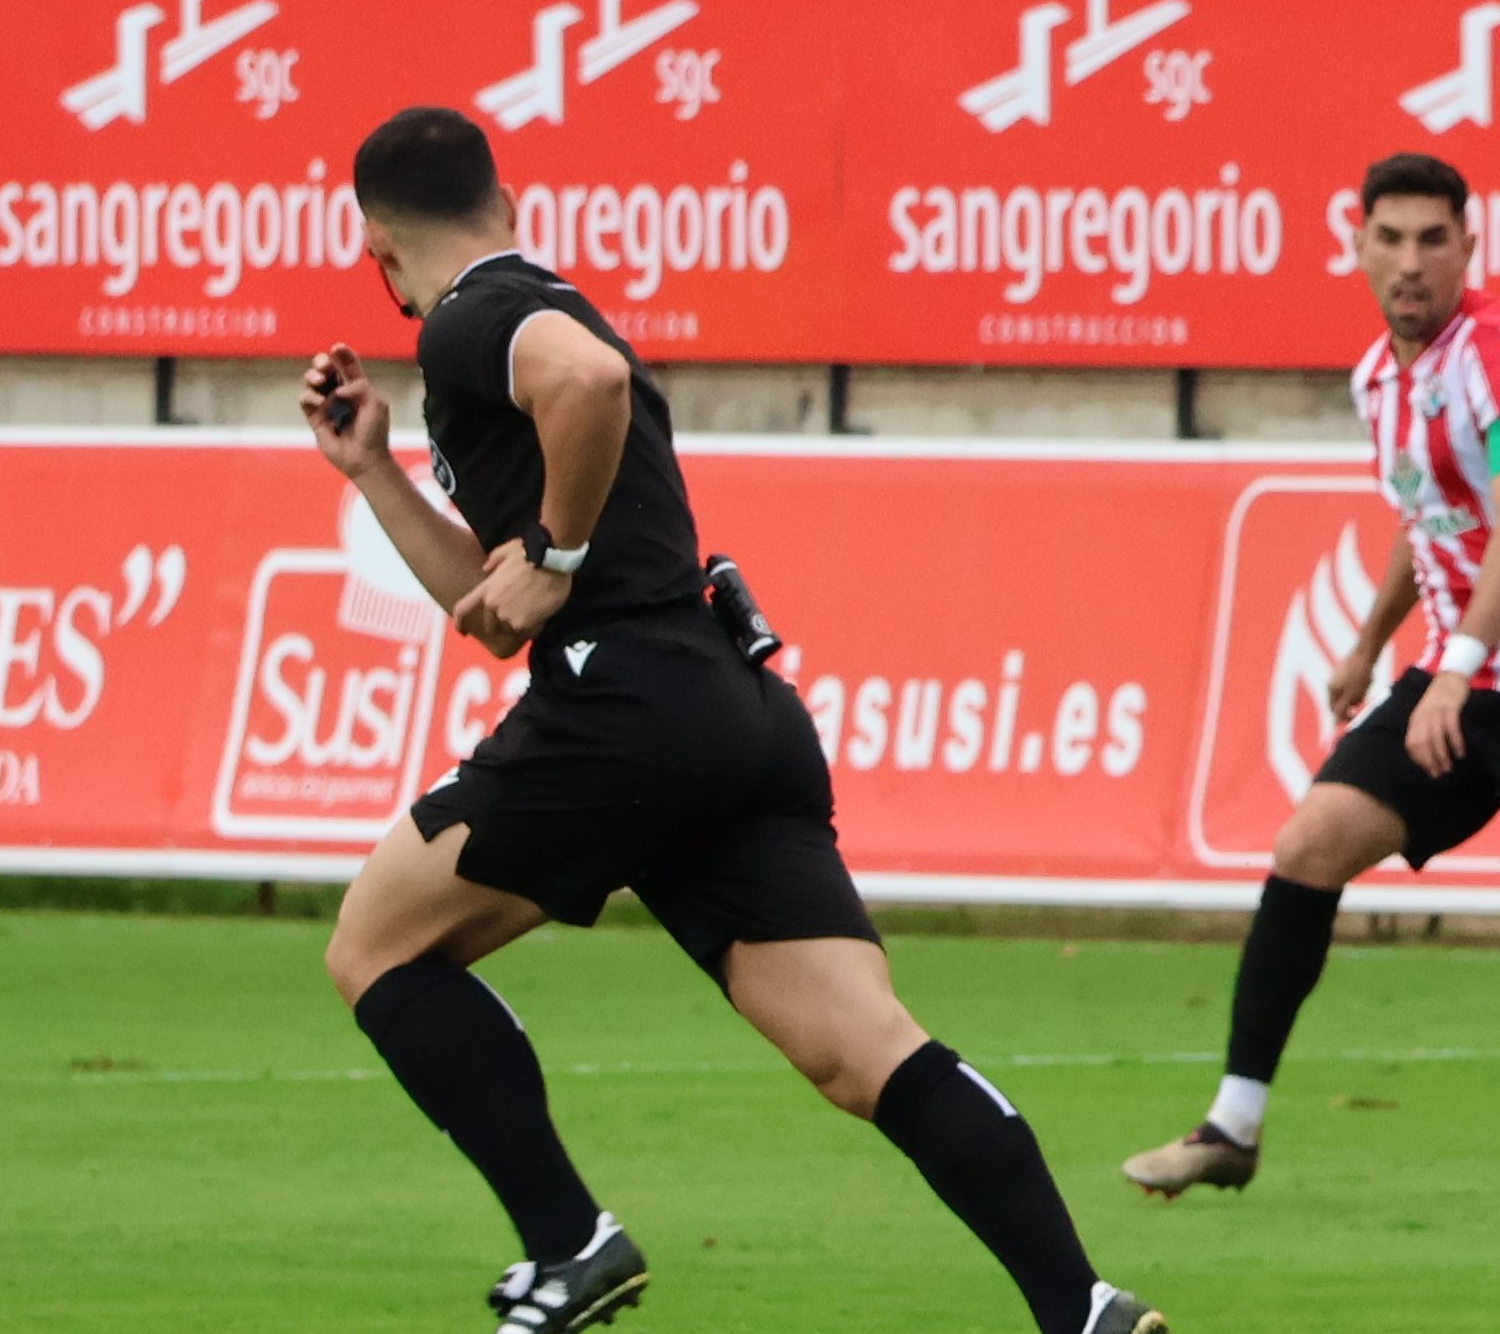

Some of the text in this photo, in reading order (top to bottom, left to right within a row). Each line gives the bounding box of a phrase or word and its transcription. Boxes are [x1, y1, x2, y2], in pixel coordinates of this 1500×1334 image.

[236, 48, 299, 120] sgc
[654, 48, 722, 121] sgc
[1143, 50, 1213, 121] sgc
[888, 161, 1284, 304] sangregorio
[246, 632, 420, 768] Susi
